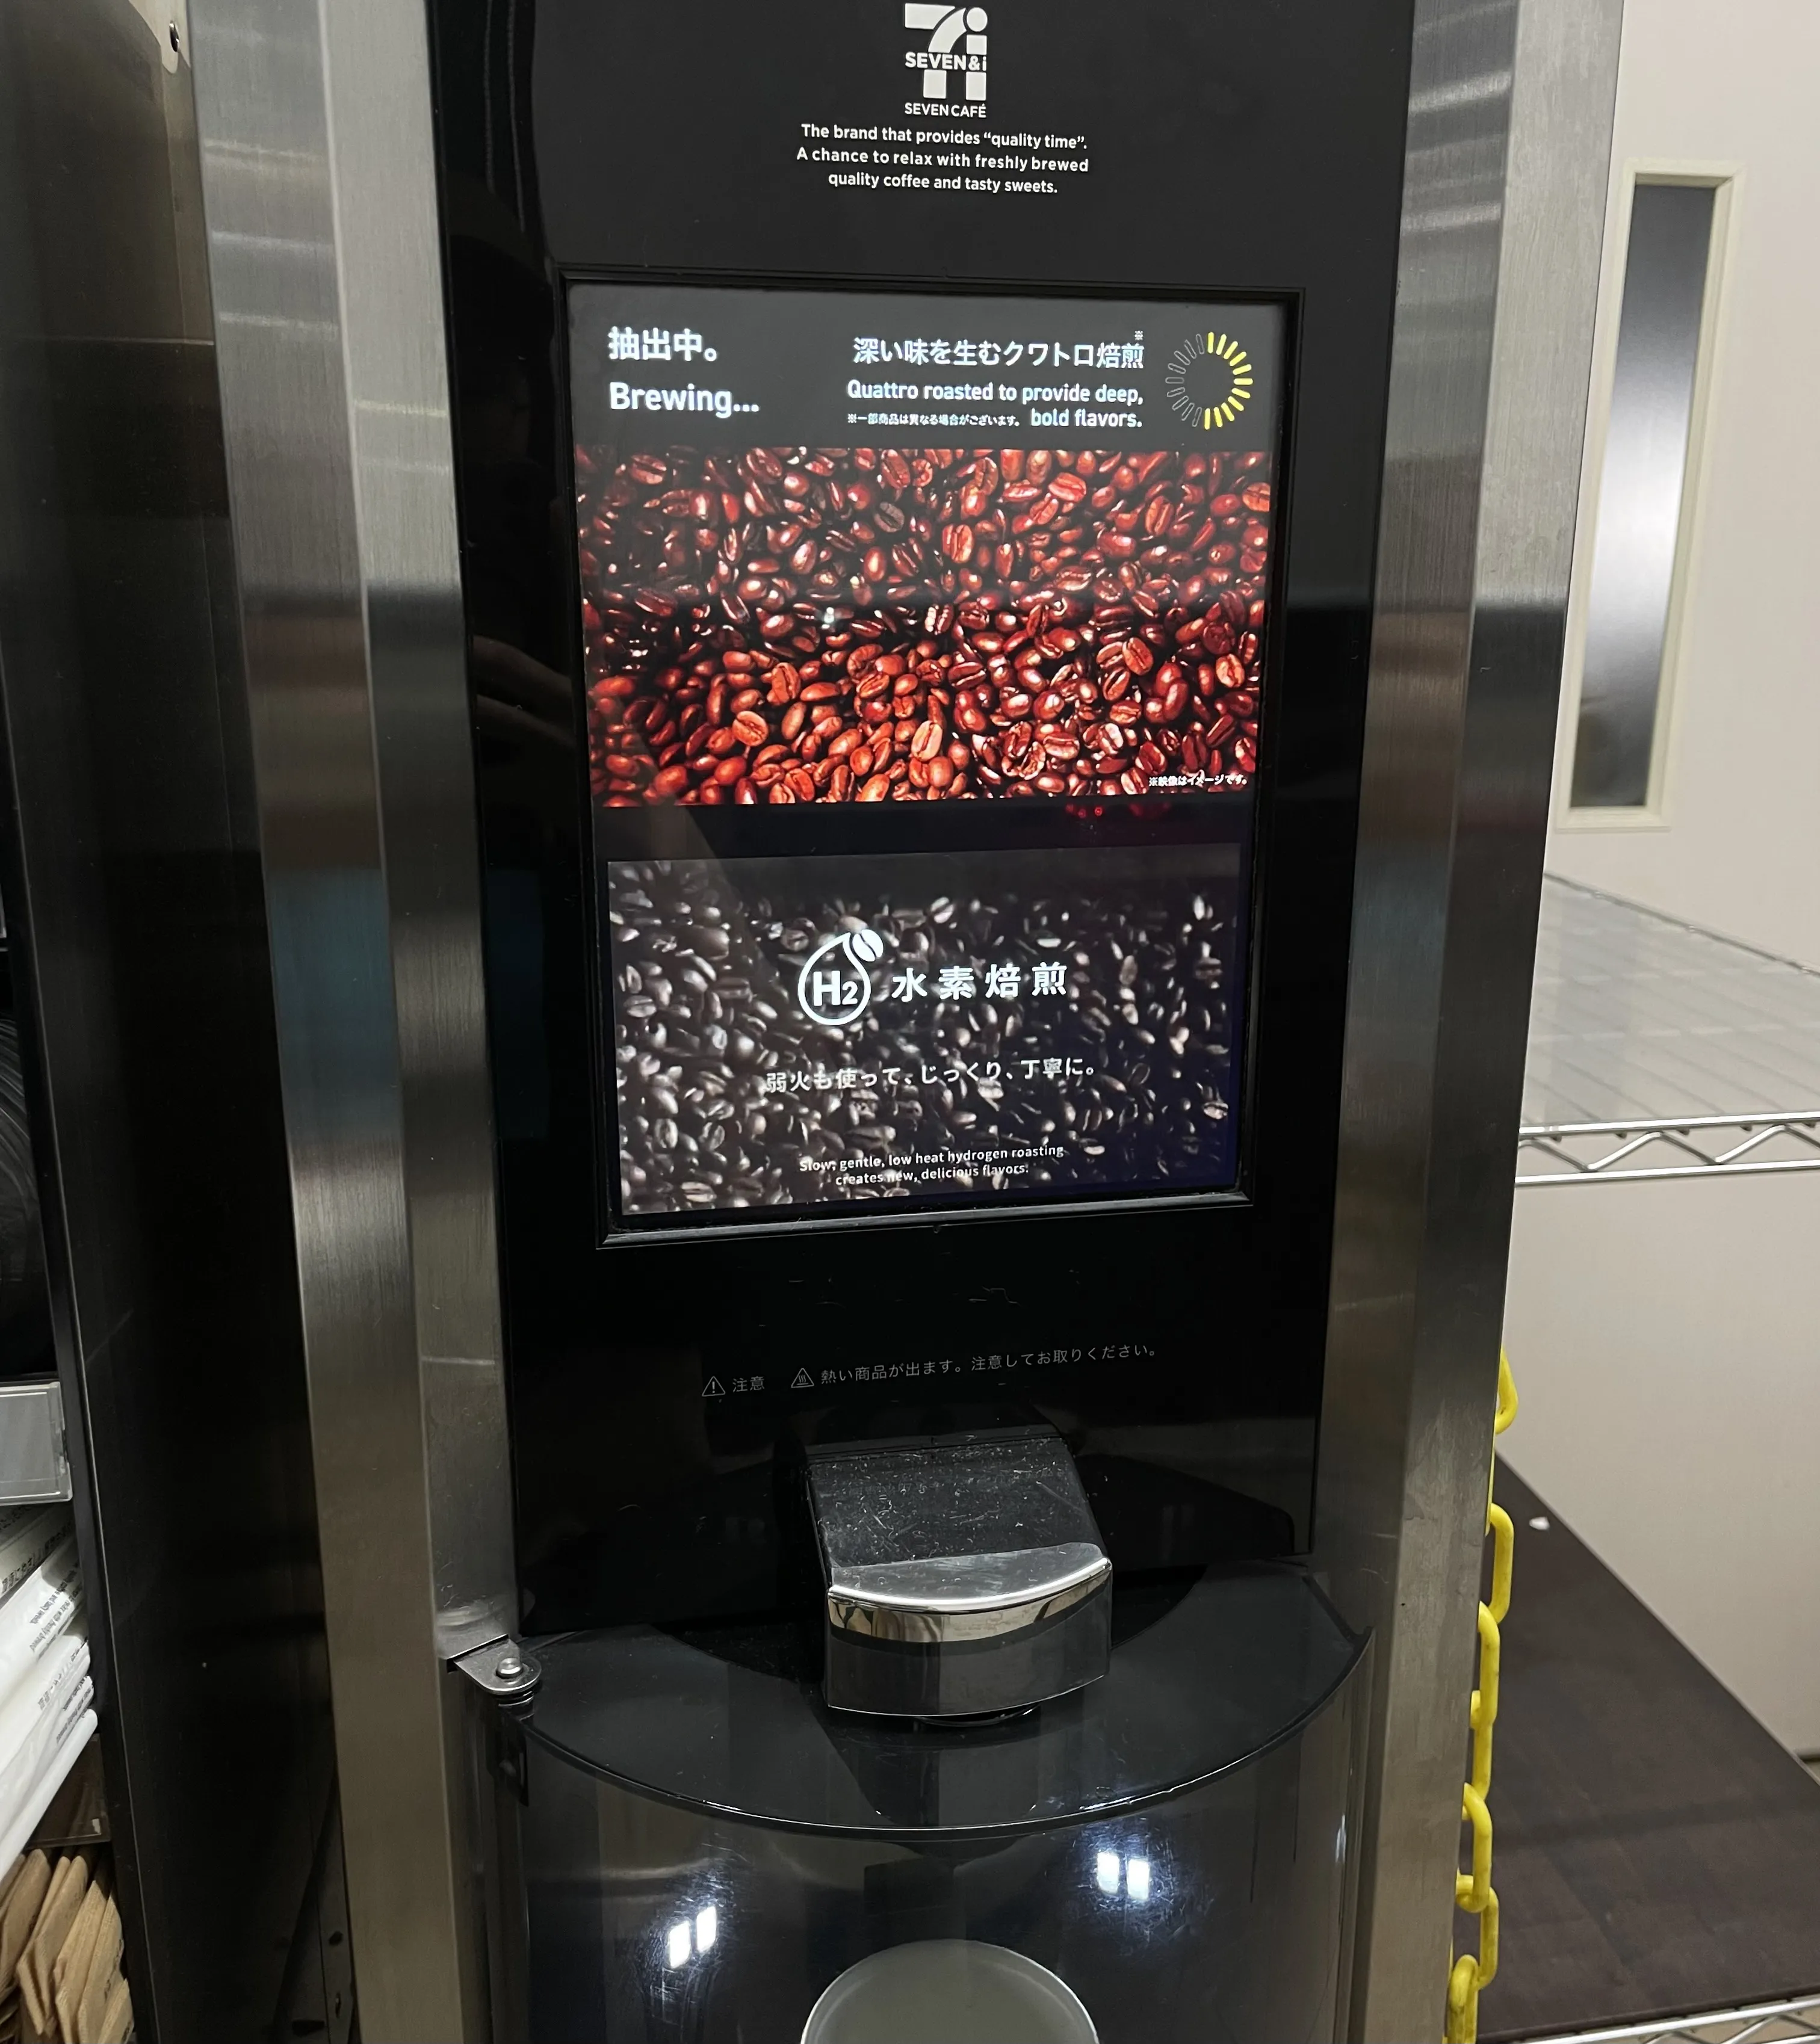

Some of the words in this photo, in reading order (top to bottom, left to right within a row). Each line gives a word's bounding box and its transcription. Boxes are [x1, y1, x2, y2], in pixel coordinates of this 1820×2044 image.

[905, 103, 949, 116] SEVEN
[951, 103, 986, 117] CAFÉ
[801, 124, 829, 137] The
[834, 125, 877, 140] brand
[882, 127, 911, 141] that
[917, 130, 980, 144] provides
[797, 147, 808, 160] A
[812, 147, 868, 162] chance
[873, 150, 889, 163] to
[894, 151, 932, 165] relax
[937, 153, 970, 167] with
[976, 154, 1027, 171] freshly
[1032, 156, 1088, 171] brewed
[829, 172, 879, 188] quality
[884, 174, 929, 188] coffee
[934, 176, 961, 189] and
[965, 178, 1000, 193] tasty
[1005, 181, 1057, 193] sweets.
[608, 326, 717, 361] 抽出中。
[847, 380, 918, 399] Quattro
[924, 382, 993, 400] roasted
[998, 384, 1017, 401] to
[1023, 383, 1090, 404] provide
[1095, 384, 1143, 406] deep,
[1031, 408, 1069, 426] bold
[1074, 409, 1142, 427] flavors.
[840, 1156, 885, 1172] gentle,
[888, 1154, 912, 1166] low
[915, 1152, 944, 1164] heat
[948, 1149, 1008, 1164] hydrogen
[1012, 1145, 1064, 1158] roasting
[835, 1173, 884, 1185] creates
[921, 1167, 979, 1180] delicious
[982, 1164, 1029, 1176] flavors.
[732, 1376, 765, 1392] 注意
